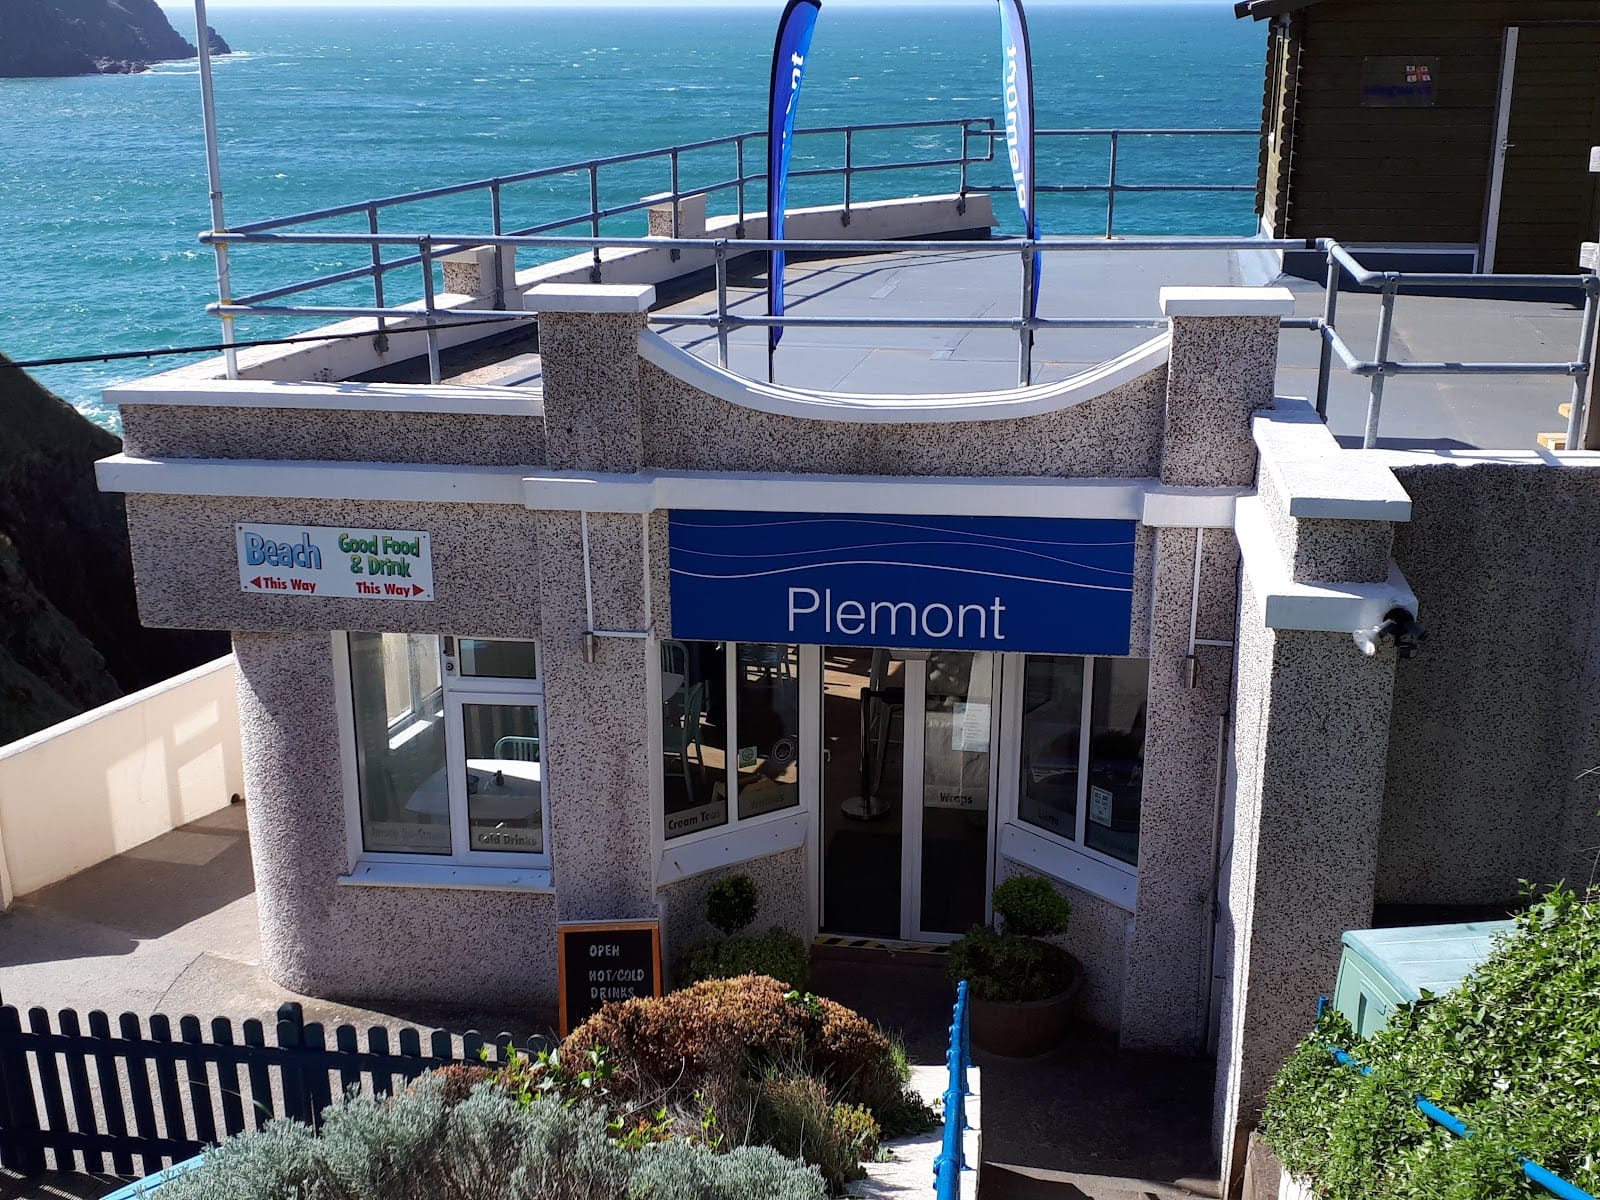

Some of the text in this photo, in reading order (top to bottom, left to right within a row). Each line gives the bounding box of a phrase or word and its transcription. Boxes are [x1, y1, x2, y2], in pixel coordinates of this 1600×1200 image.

[244, 532, 322, 570] Beach
[338, 533, 420, 558] Good Food
[350, 555, 412, 578] & Drink
[262, 577, 316, 594] This Way
[356, 581, 411, 598] This Way
[788, 586, 1006, 640] Plemont
[940, 791, 973, 807] Wraps
[668, 816, 698, 830] Cream
[503, 833, 537, 847] Drinks
[589, 944, 620, 957] OPEN
[588, 968, 645, 983] HOT/COLD
[590, 986, 635, 1001] DRINKS
